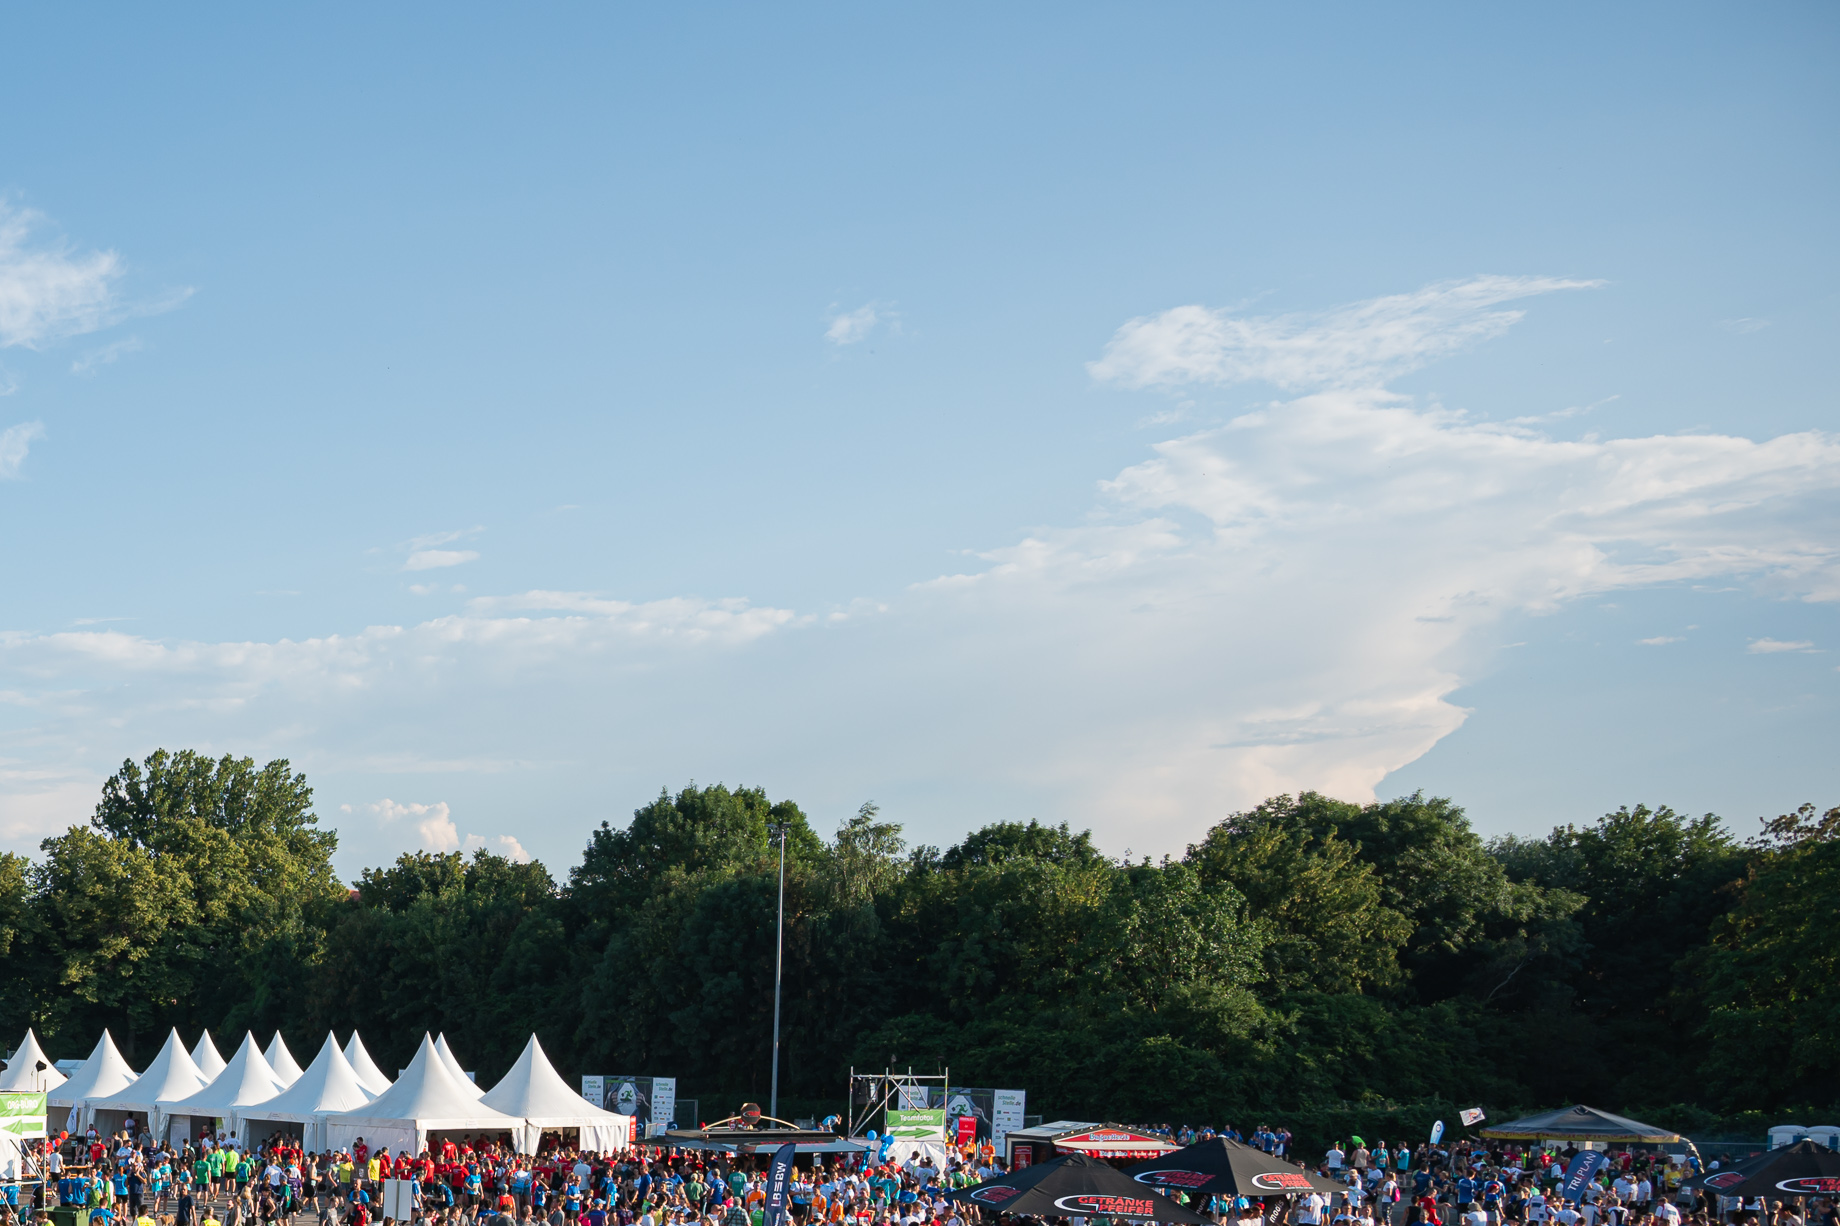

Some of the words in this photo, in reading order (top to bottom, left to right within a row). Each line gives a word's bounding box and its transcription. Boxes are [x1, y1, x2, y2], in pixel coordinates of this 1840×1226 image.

[899, 1114, 933, 1122] Teamfotos
[1078, 1195, 1154, 1207] GETRÄNKE
[1098, 1204, 1154, 1215] PFEIFER
